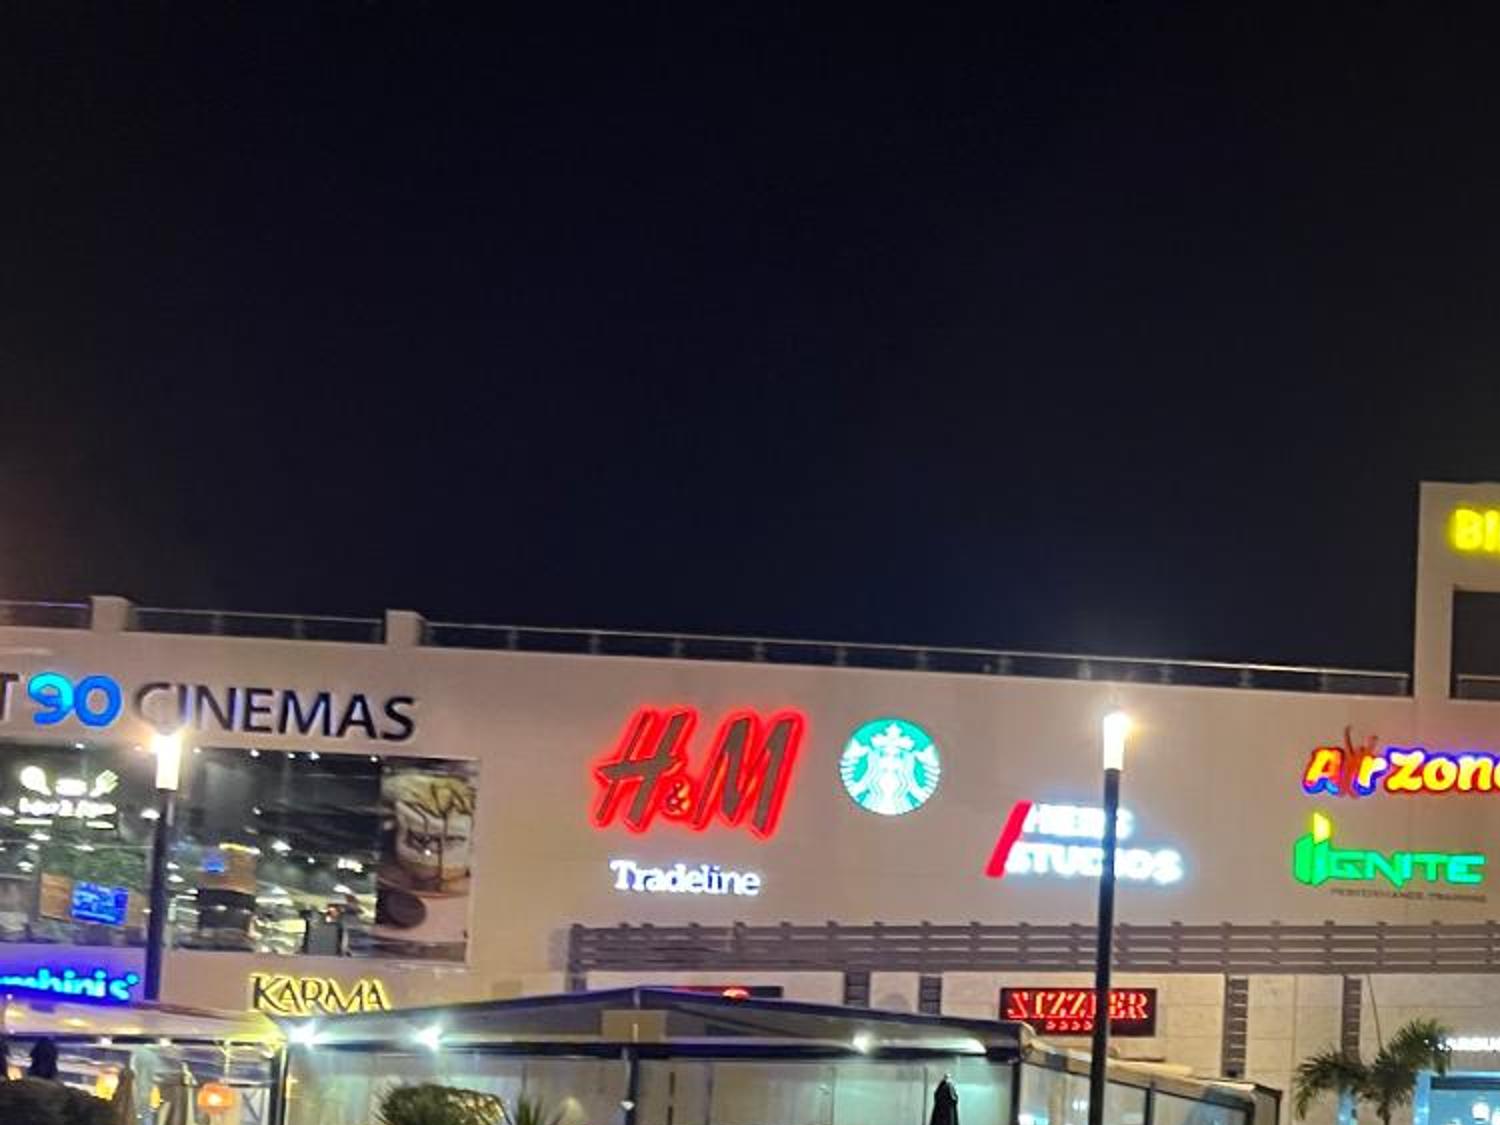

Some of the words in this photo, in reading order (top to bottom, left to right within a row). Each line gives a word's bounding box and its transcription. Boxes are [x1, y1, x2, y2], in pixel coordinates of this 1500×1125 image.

[27, 672, 123, 727] 90
[131, 681, 416, 742] CINEMAS
[592, 706, 804, 840] H&M
[608, 859, 762, 896] Tradeline
[250, 974, 392, 1018] KARMA
[1006, 991, 1150, 1020] SIZZER
